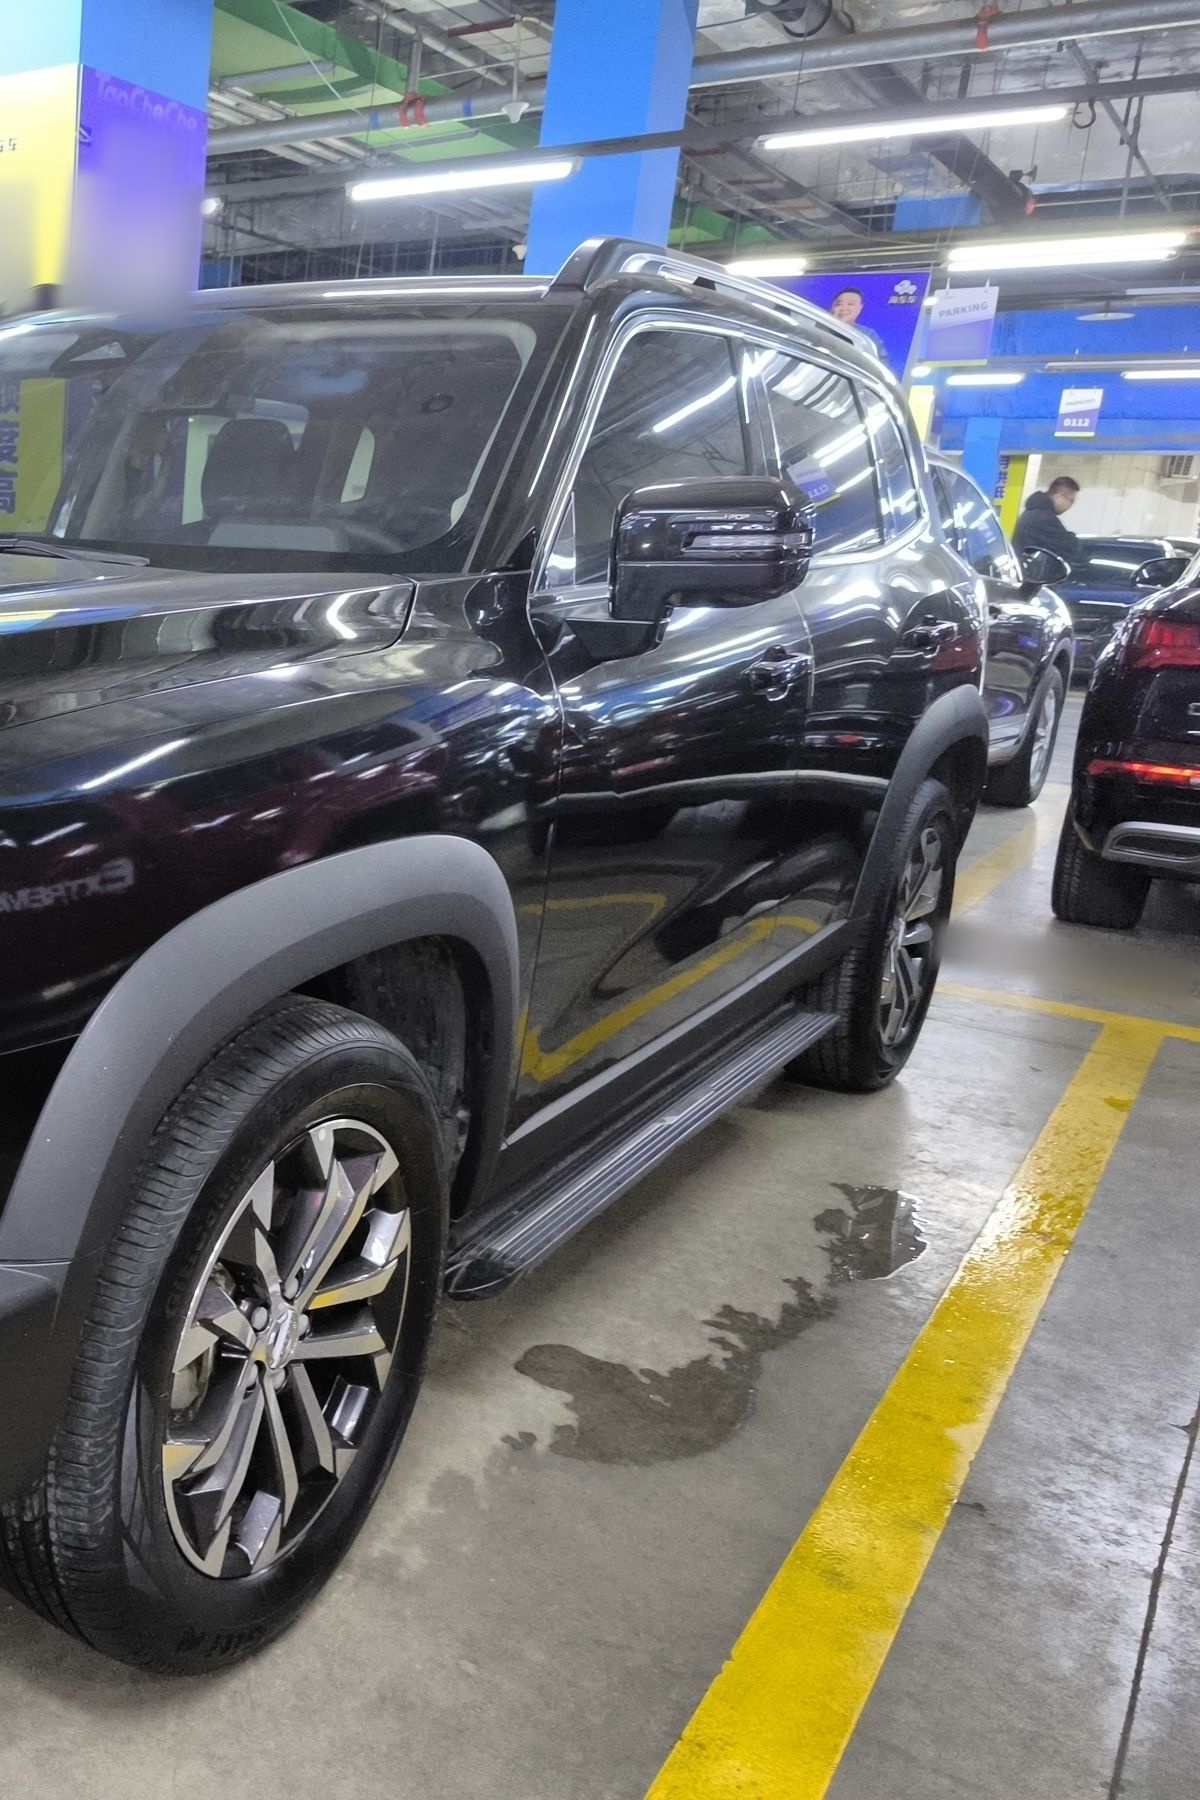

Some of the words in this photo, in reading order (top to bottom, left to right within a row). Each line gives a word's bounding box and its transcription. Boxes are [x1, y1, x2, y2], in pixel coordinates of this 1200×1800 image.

[95, 73, 199, 131] TaoCheChe
[938, 301, 989, 318] PARKING
[1063, 418, 1090, 427] D112
